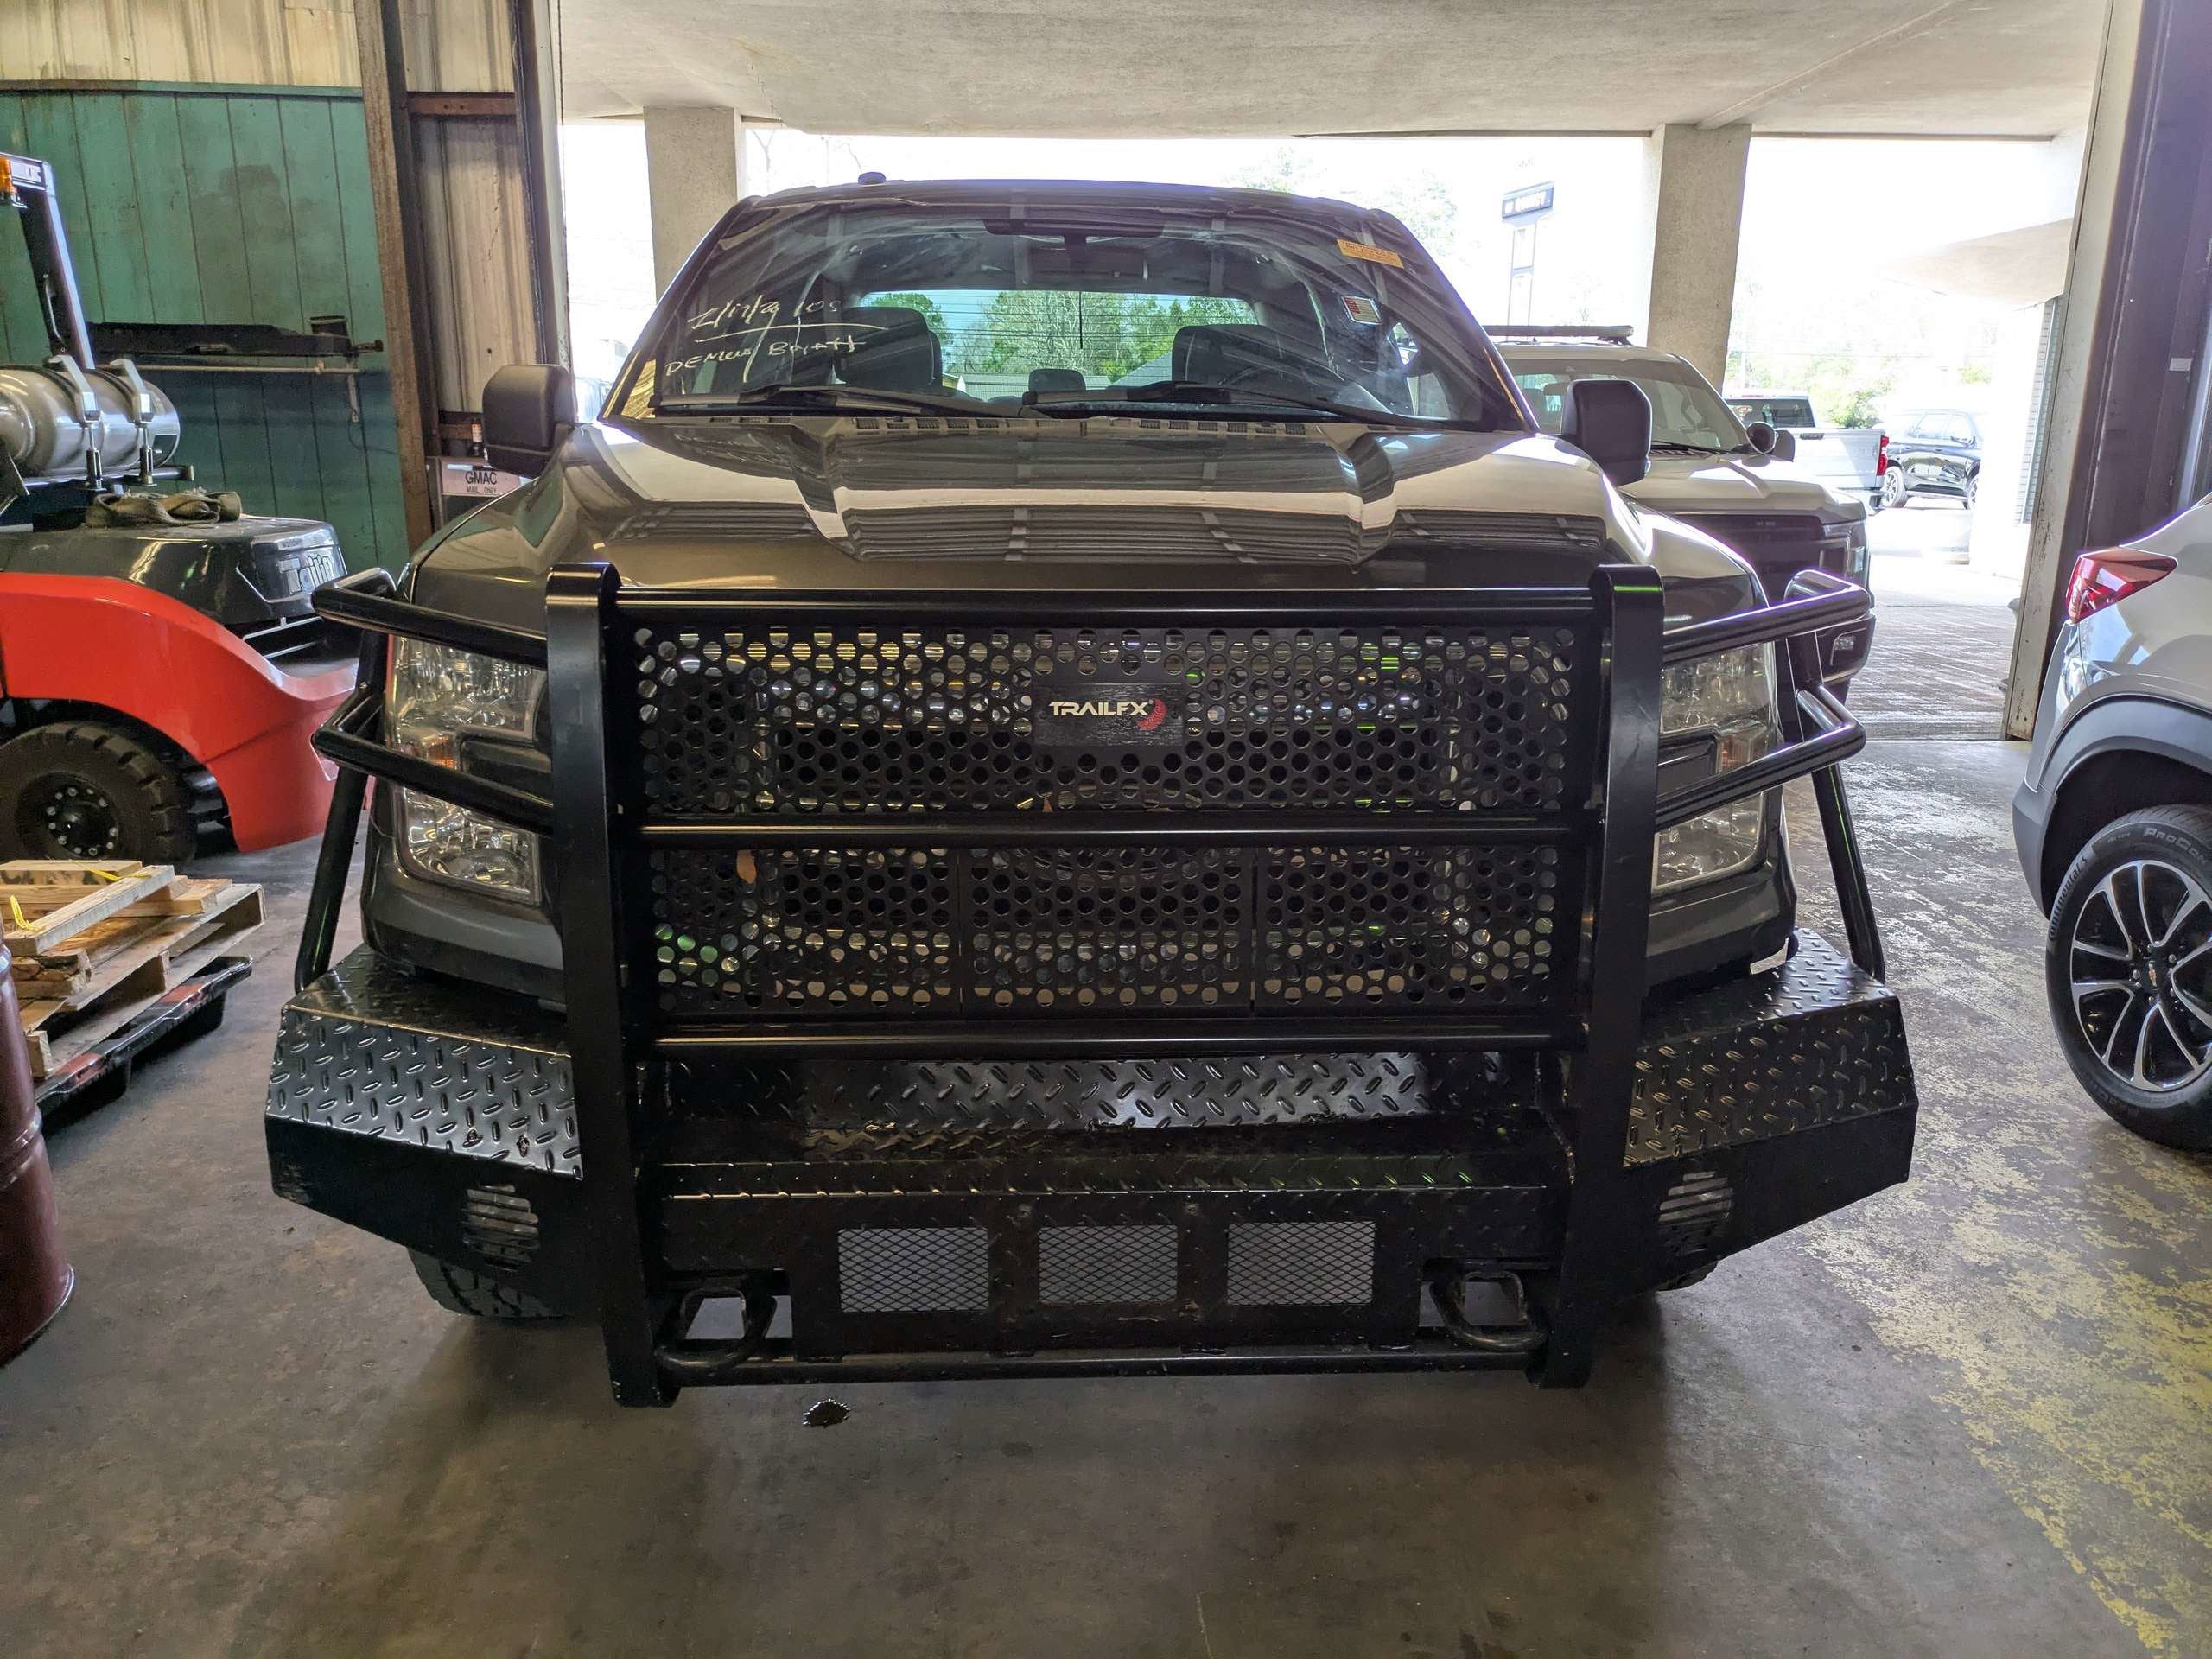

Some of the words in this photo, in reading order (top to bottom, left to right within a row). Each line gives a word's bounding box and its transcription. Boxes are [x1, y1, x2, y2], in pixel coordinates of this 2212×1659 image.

[465, 470, 498, 485] GMAC
[1048, 702, 1149, 716] TRAILFX
[2049, 863, 2081, 941] Continental
